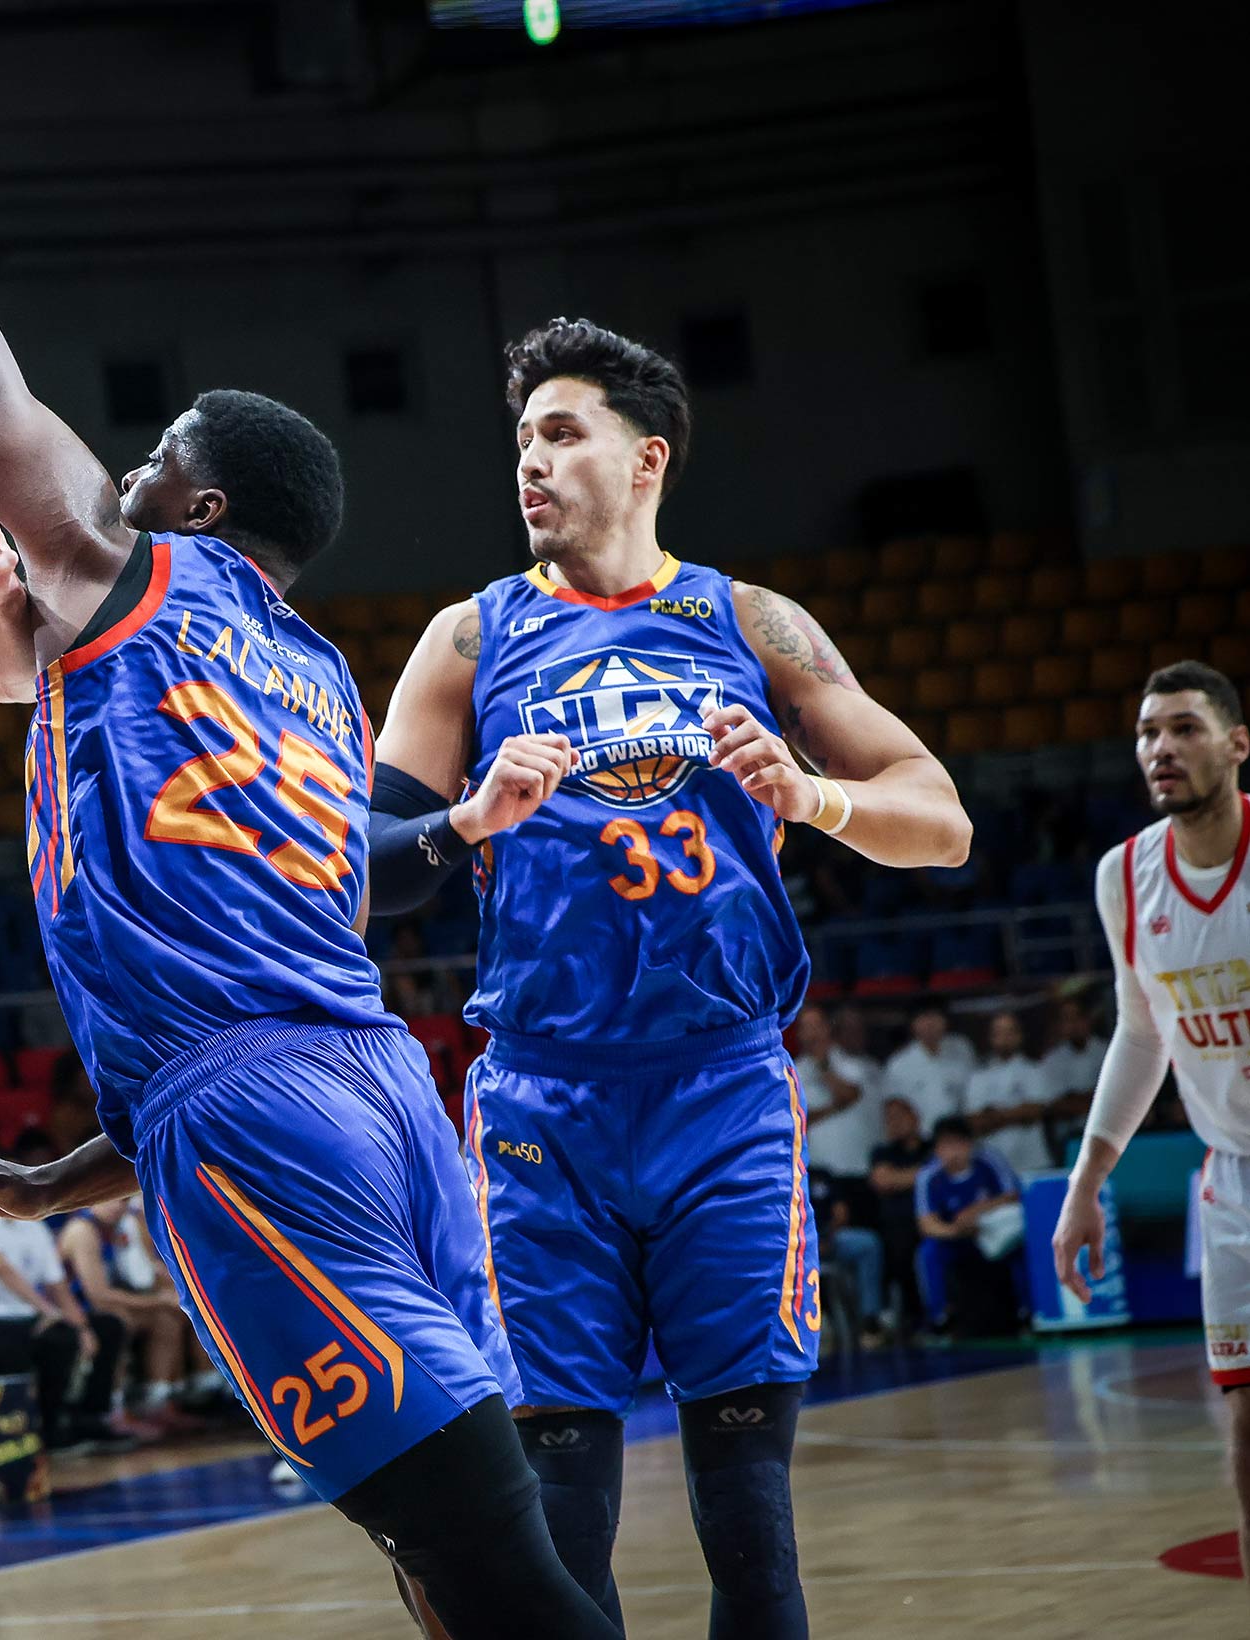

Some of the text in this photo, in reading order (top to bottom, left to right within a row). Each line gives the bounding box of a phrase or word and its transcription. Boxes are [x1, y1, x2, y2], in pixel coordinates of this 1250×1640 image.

[650, 596, 712, 619] PBA50
[176, 610, 353, 756] LALANNE
[530, 688, 714, 747] NLEX
[144, 680, 353, 893] 25
[600, 809, 716, 901] 33
[273, 1340, 370, 1446] 25
